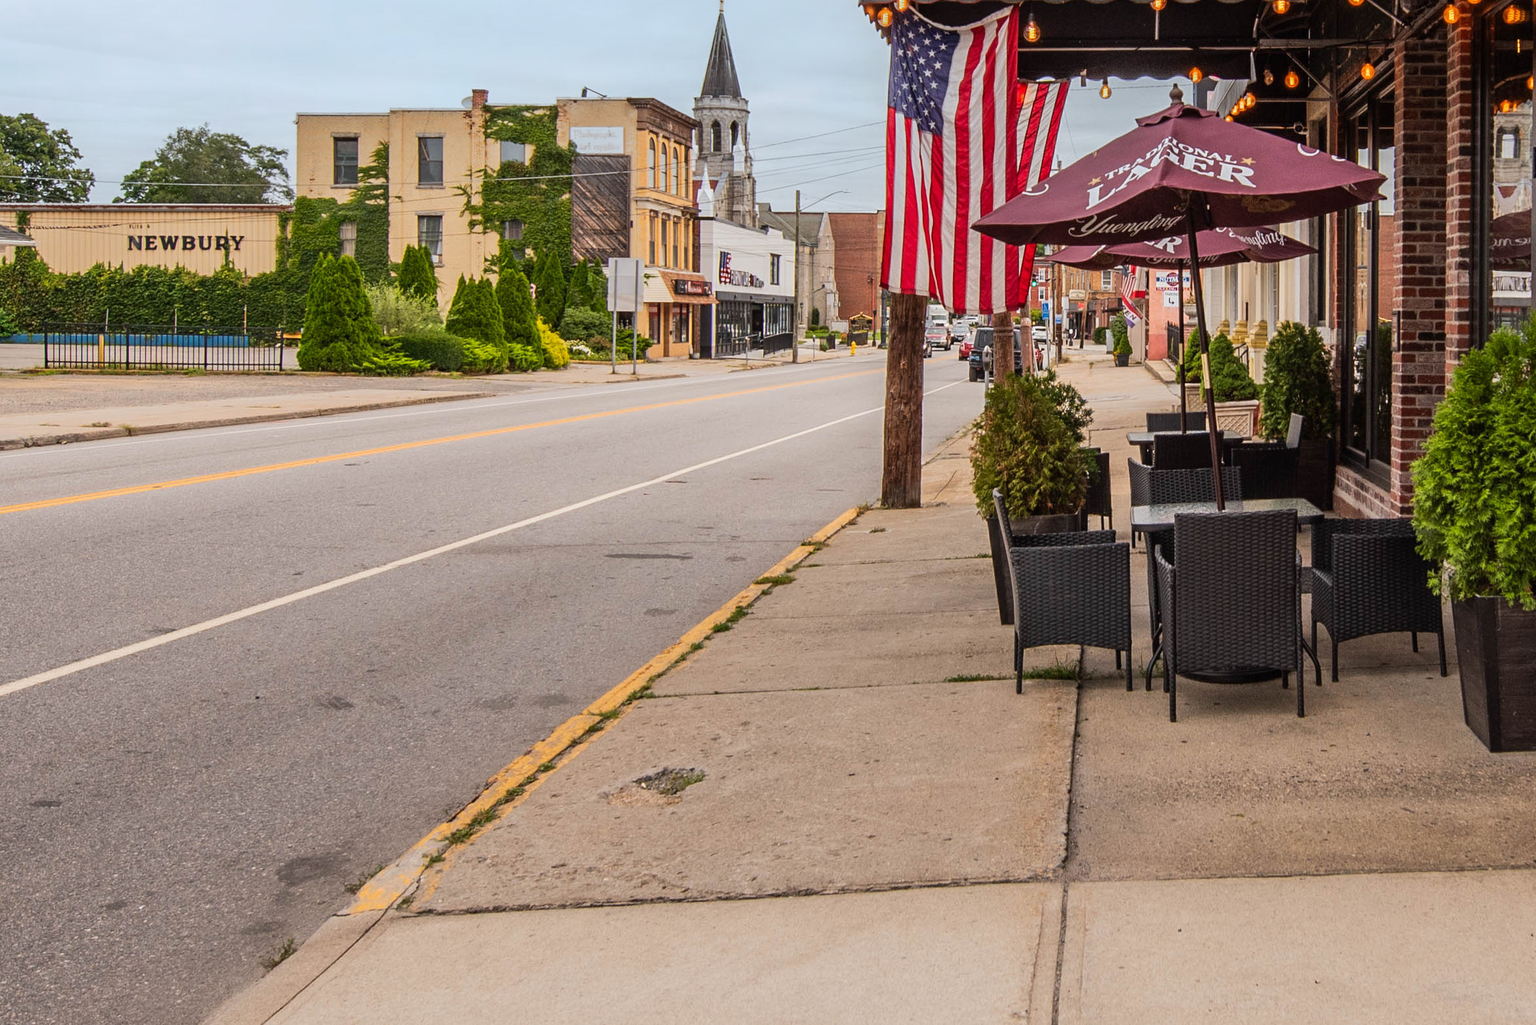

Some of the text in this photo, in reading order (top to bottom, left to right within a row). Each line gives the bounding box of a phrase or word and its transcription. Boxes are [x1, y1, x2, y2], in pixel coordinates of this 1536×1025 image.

[1104, 136, 1238, 181] TRADITIONAL
[1085, 143, 1257, 211] LAGER
[1068, 213, 1186, 237] Yuengling
[127, 235, 245, 251] NEWBURY
